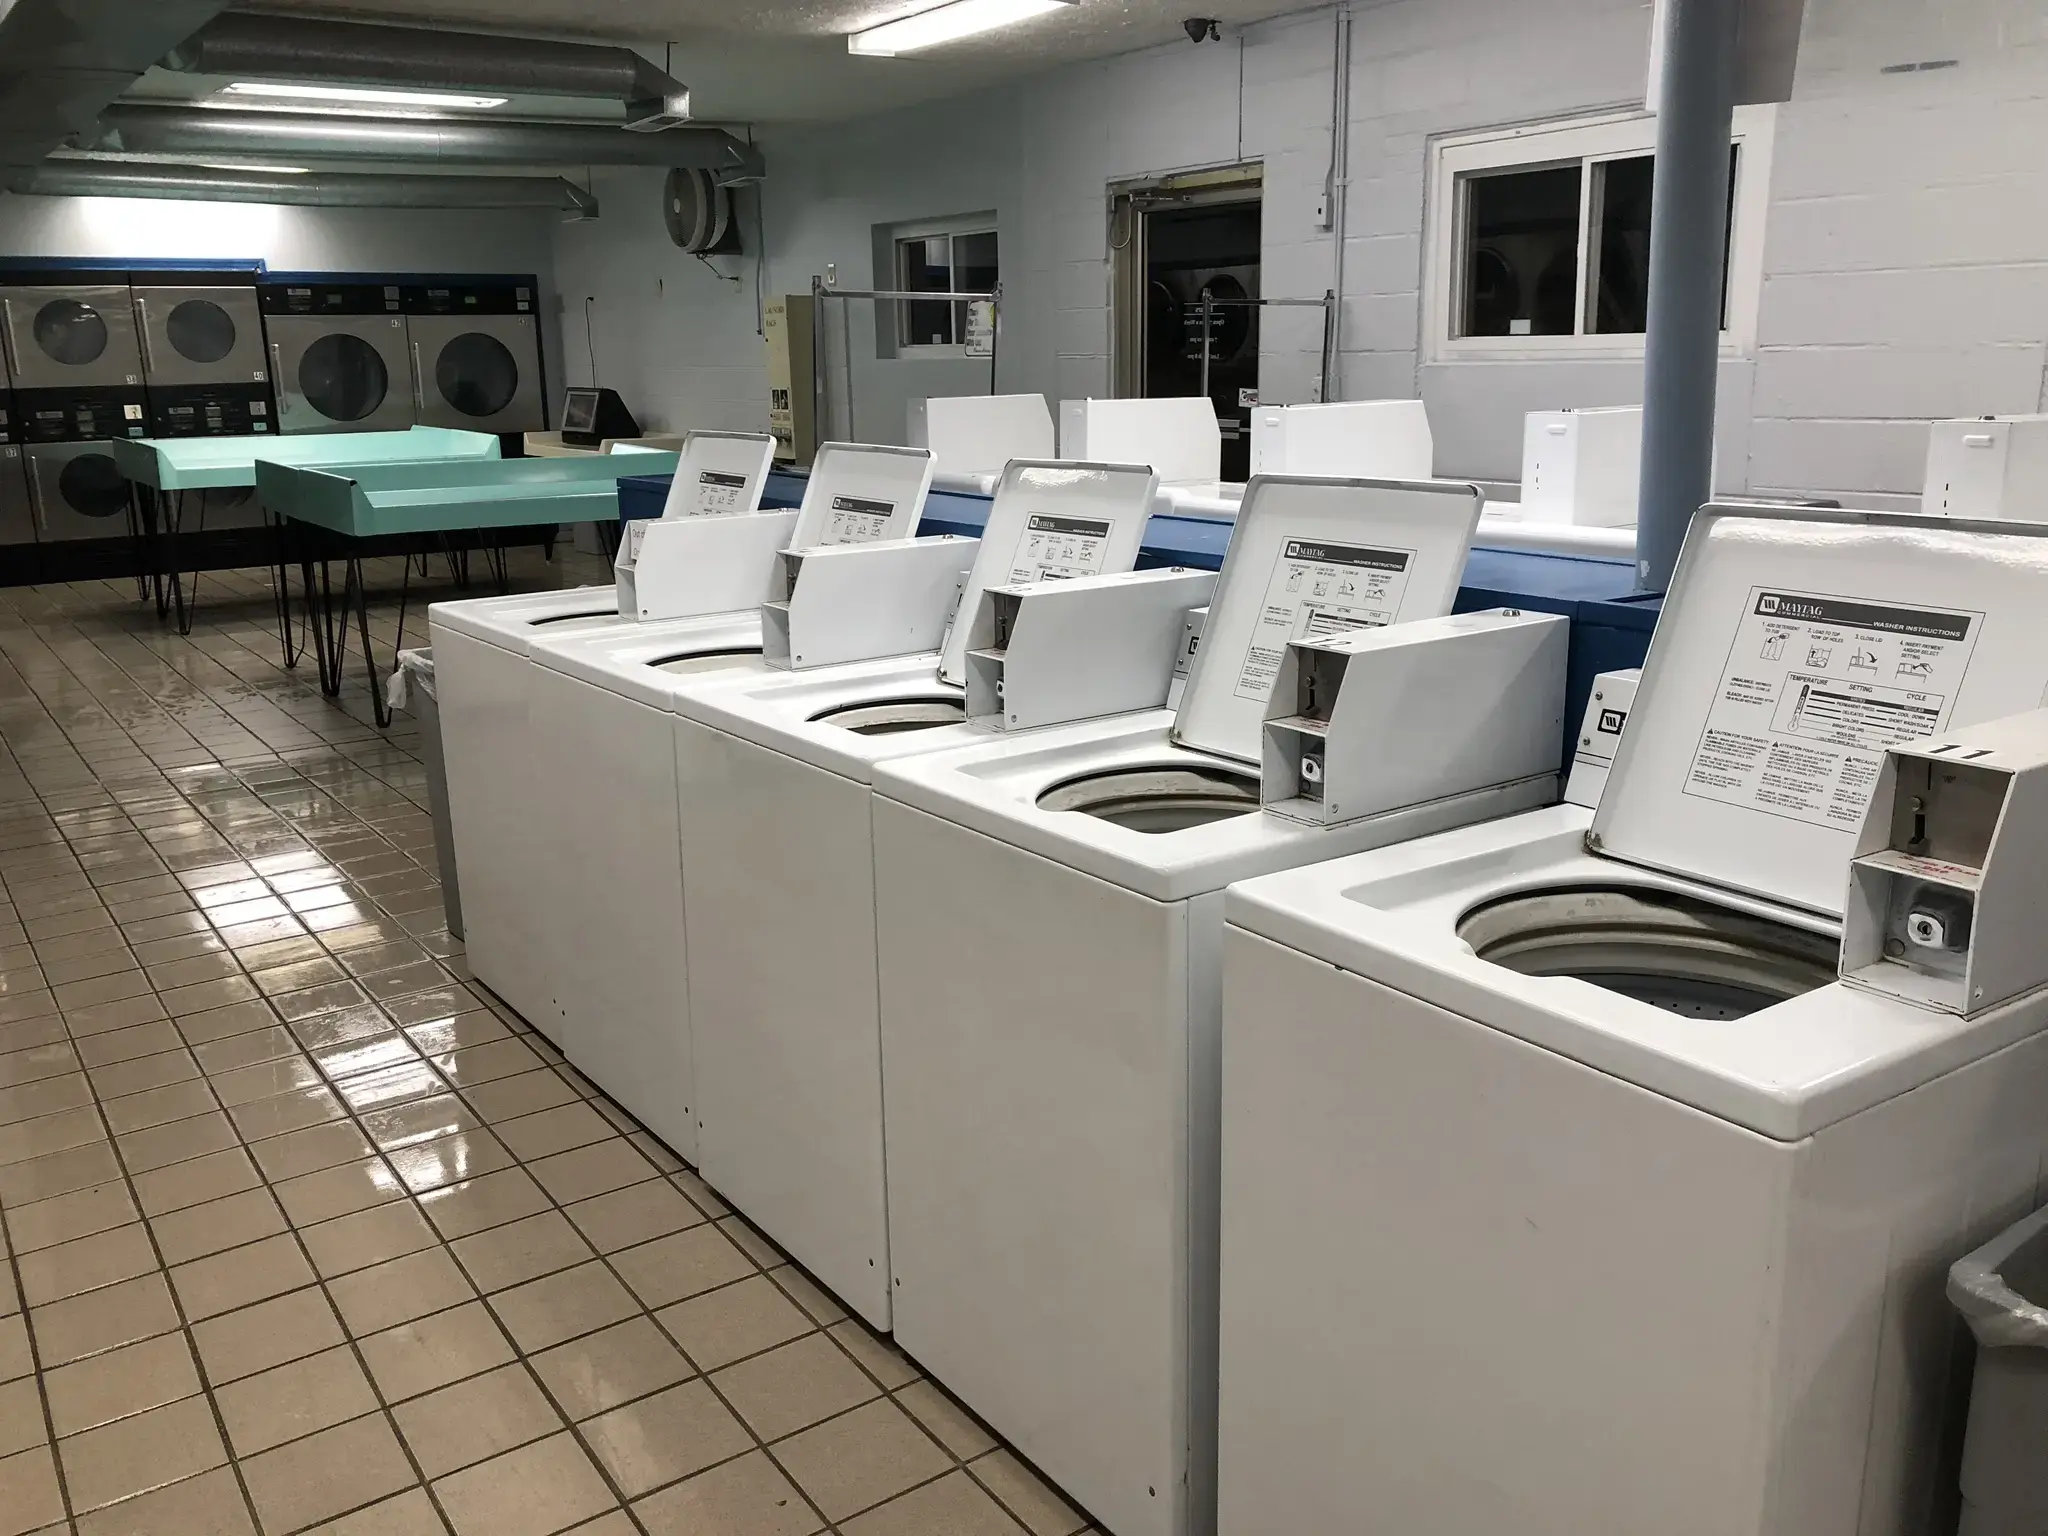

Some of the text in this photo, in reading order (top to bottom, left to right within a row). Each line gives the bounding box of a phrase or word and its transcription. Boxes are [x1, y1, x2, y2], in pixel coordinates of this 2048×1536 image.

[1299, 547, 1325, 557] MAYTAG
[1778, 601, 1823, 615] MAYTAG
[1872, 621, 1961, 637] WASHER INSTRUCTIONS
[1308, 638, 1352, 647] 12
[1789, 674, 1926, 701] TEMPERATURE SETTING CYCLE
[1835, 701, 1860, 709] PERMANENT
[1841, 709, 1864, 717] DELICATES
[1895, 726, 1917, 734] REGULAR
[1928, 744, 1995, 760] 11
